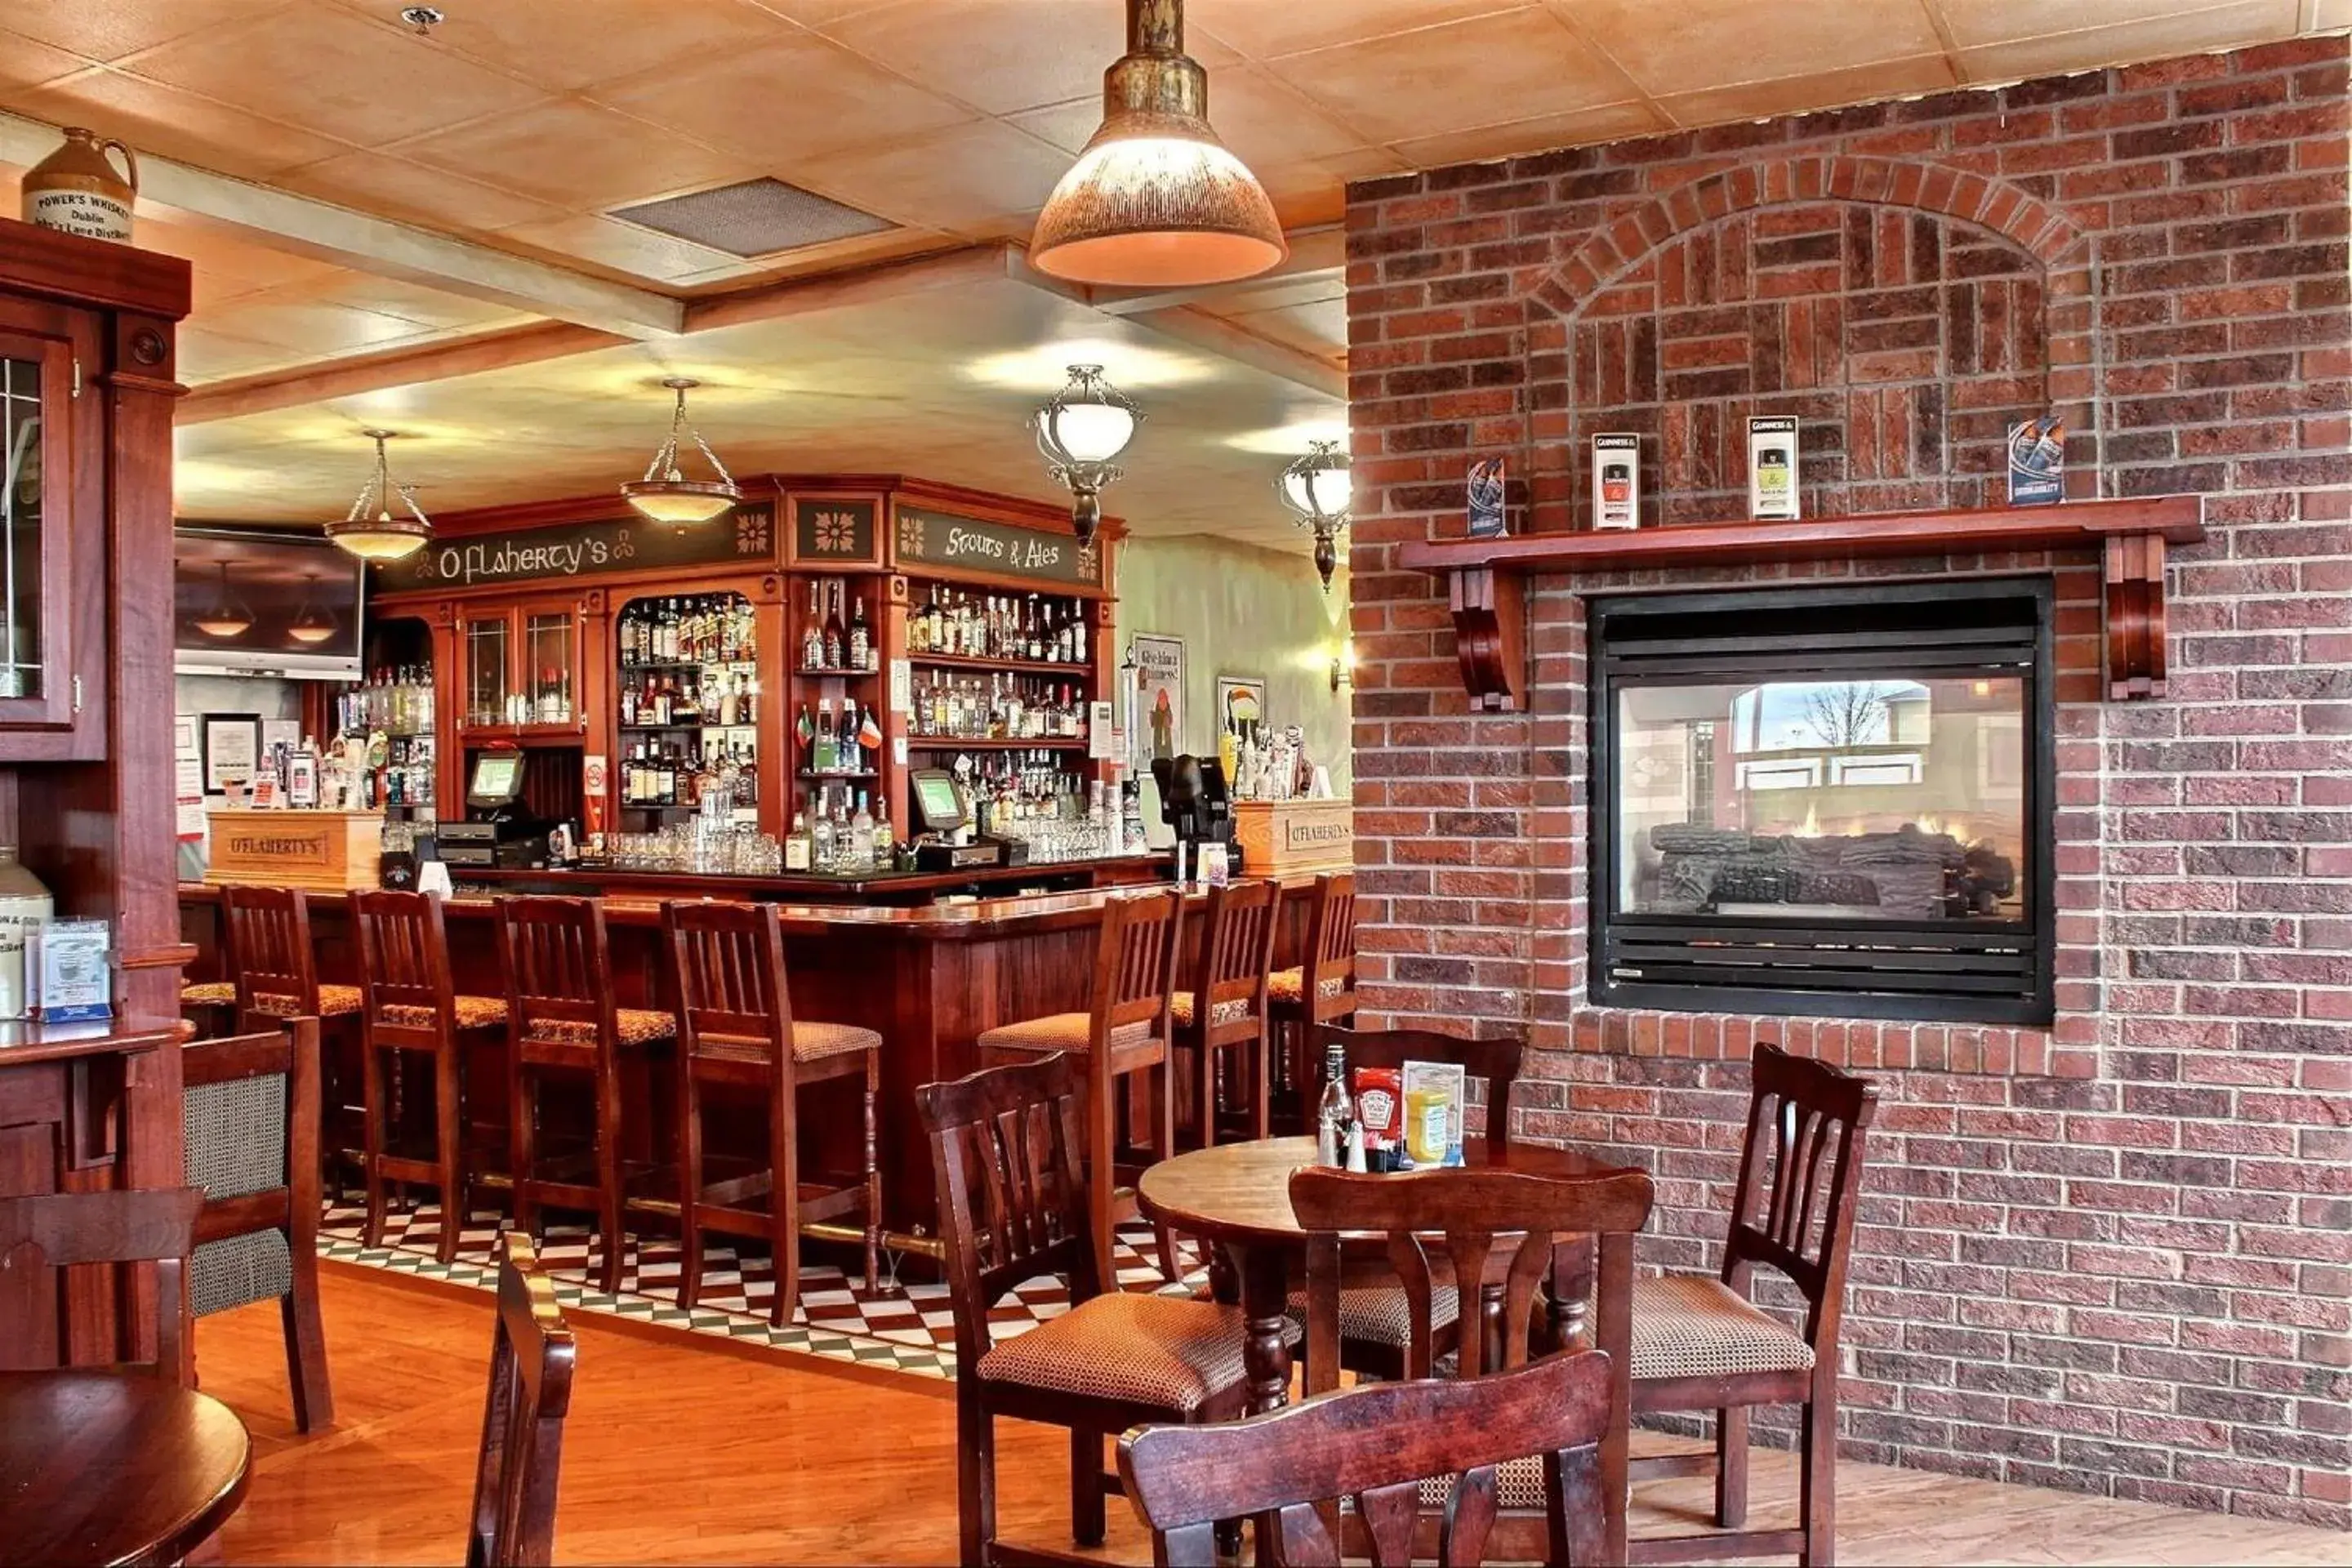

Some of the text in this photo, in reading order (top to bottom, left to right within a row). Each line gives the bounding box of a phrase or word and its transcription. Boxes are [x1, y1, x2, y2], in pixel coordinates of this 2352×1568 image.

[38, 195, 86, 208] POWER'S
[71, 210, 105, 223] Dublin
[945, 526, 1060, 568] Stouts & Ales
